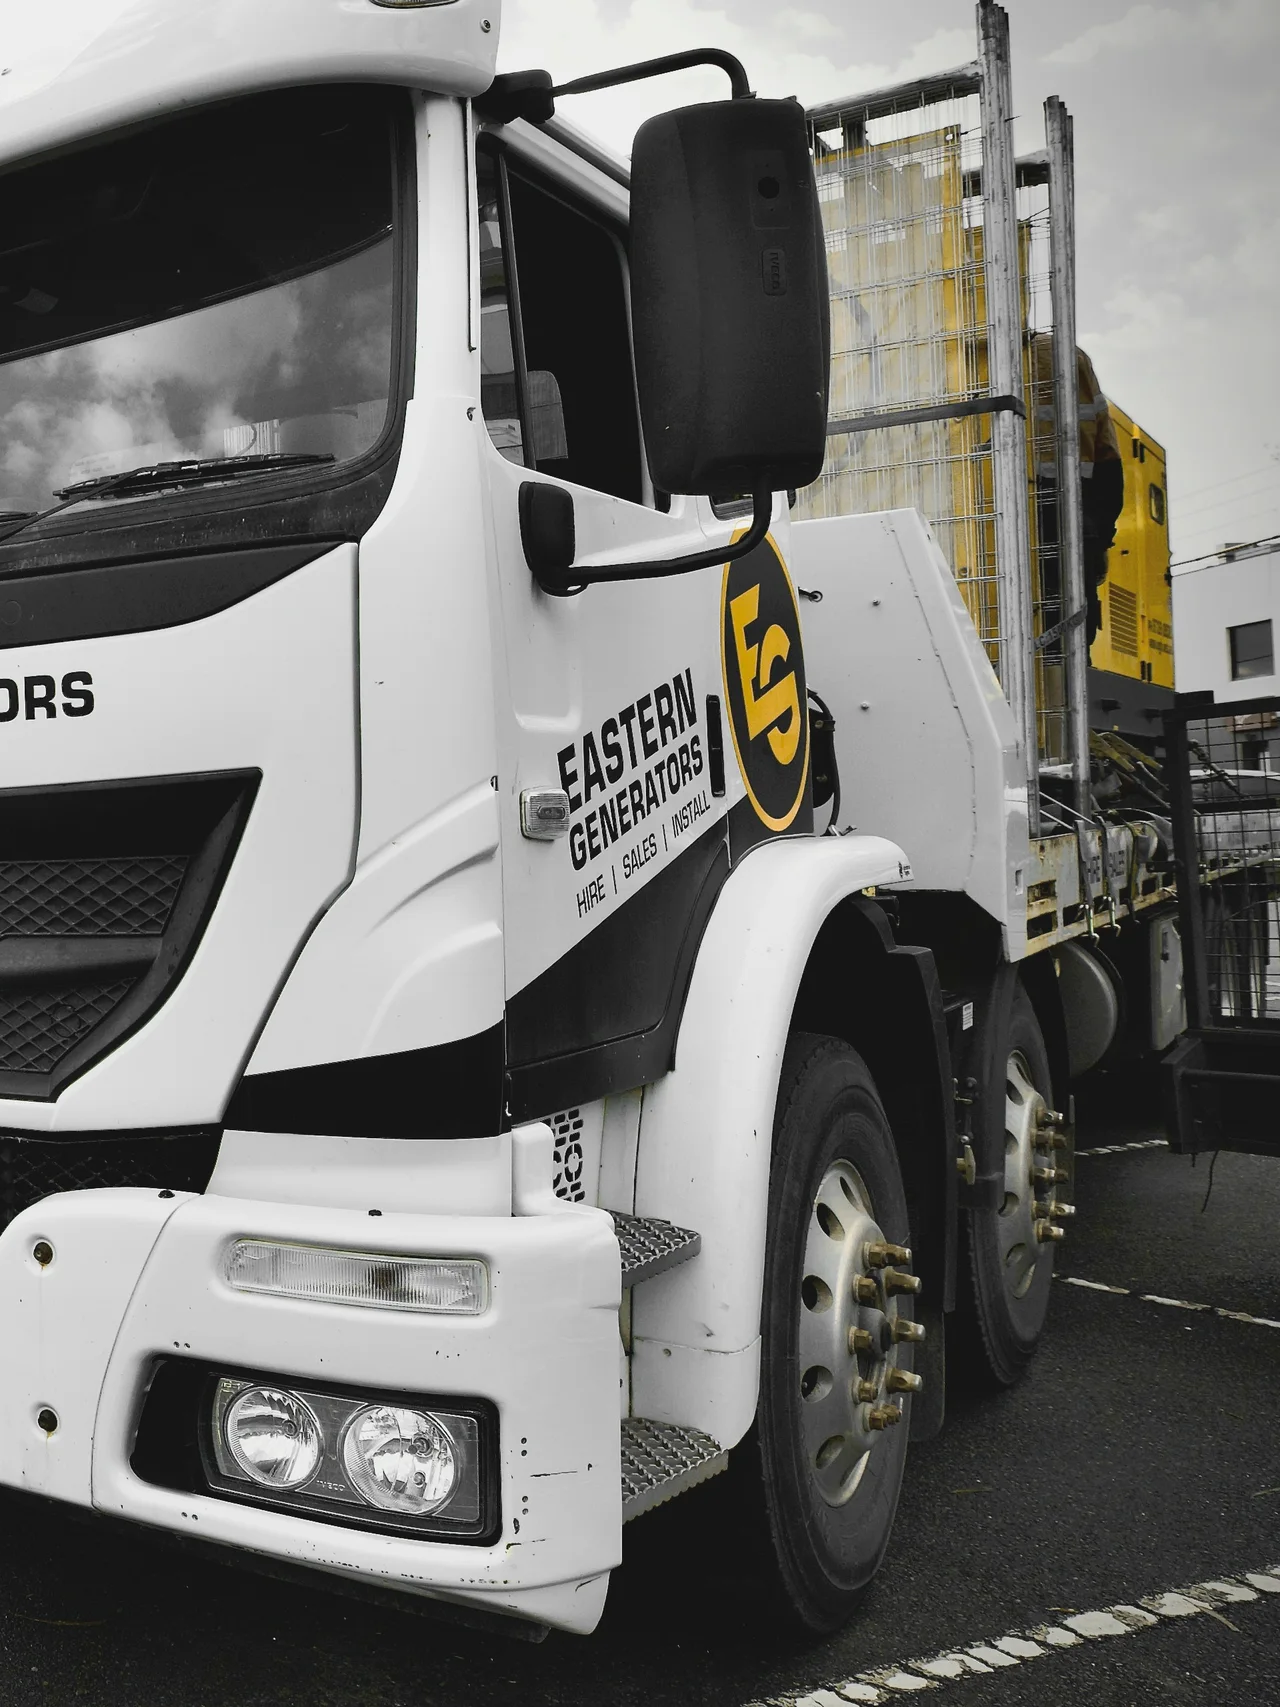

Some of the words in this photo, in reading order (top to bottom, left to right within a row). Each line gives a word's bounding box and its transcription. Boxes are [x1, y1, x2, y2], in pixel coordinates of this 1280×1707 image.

[557, 667, 698, 815] EASTERN
[569, 734, 703, 871] GENERATORS
[576, 873, 606, 918] HIRE
[622, 833, 657, 880] SALES
[671, 790, 711, 841] INSTALL
